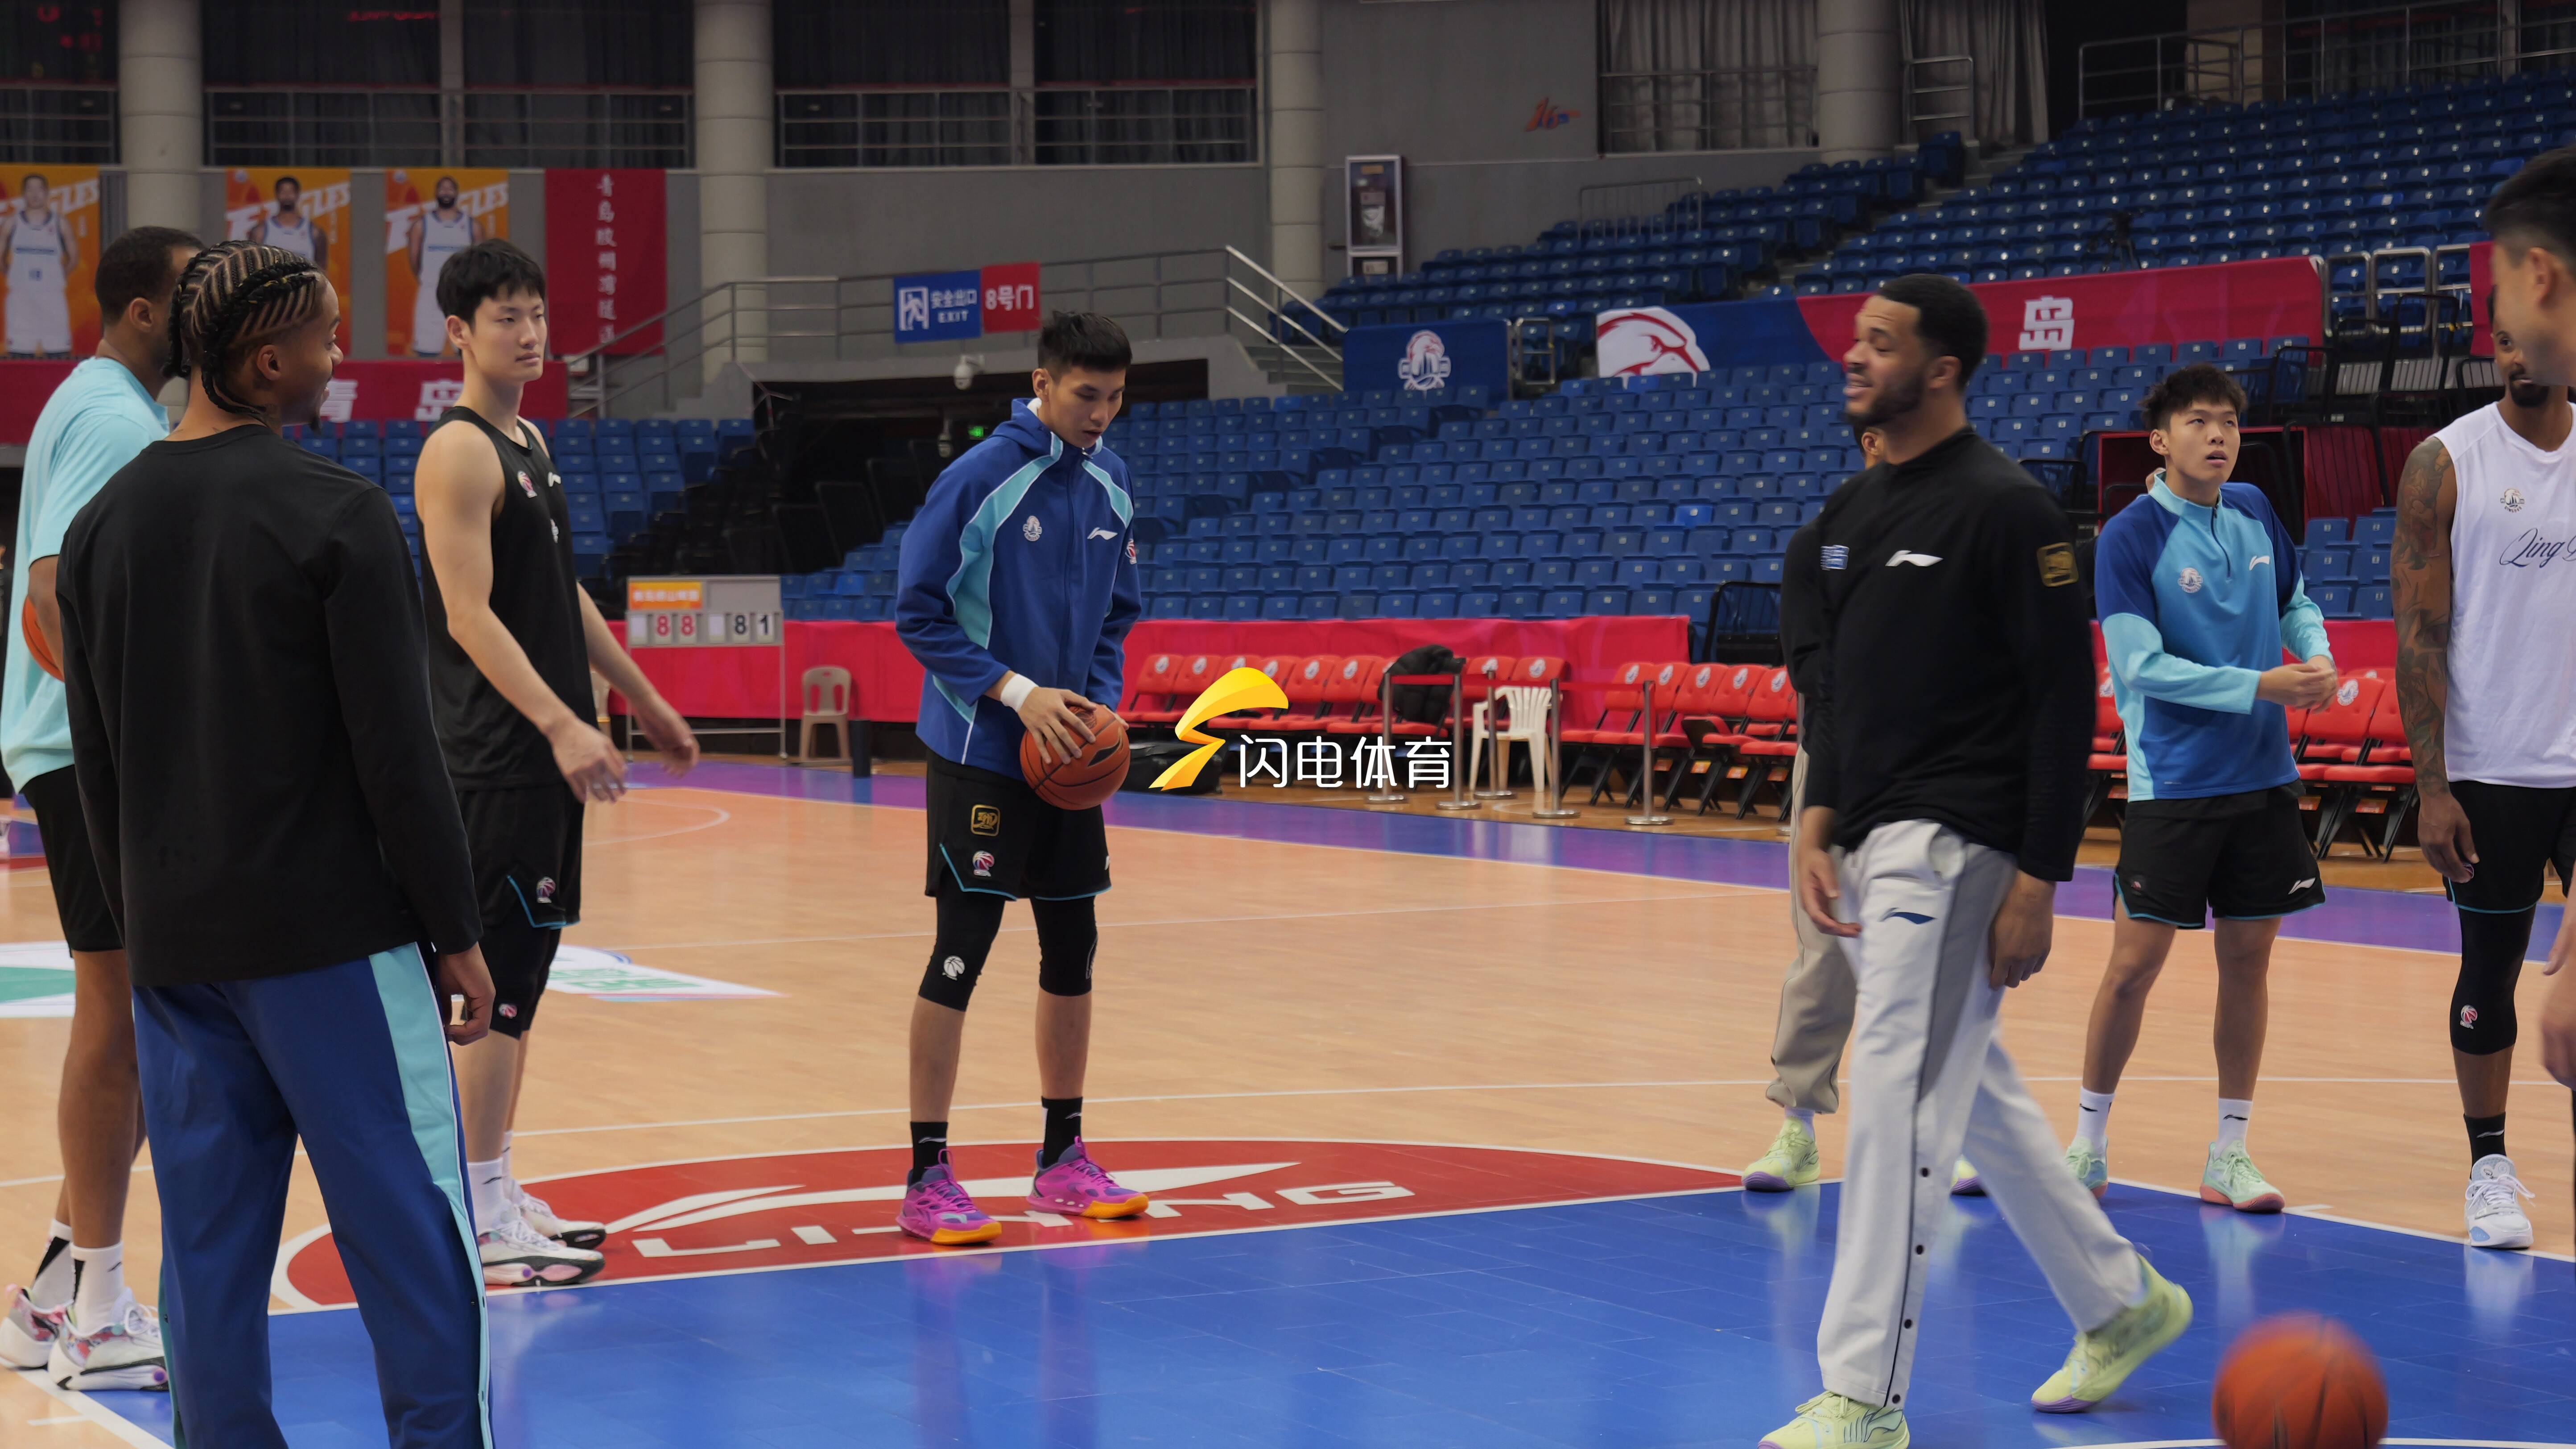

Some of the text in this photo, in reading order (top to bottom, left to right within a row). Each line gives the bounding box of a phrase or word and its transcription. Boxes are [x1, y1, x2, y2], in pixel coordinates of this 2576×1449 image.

[931, 289, 978, 309] 安全出口
[985, 284, 1034, 311] 8号门
[938, 310, 968, 323] EXIT
[2019, 296, 2075, 352] 岛
[2499, 528, 2565, 568] Qing
